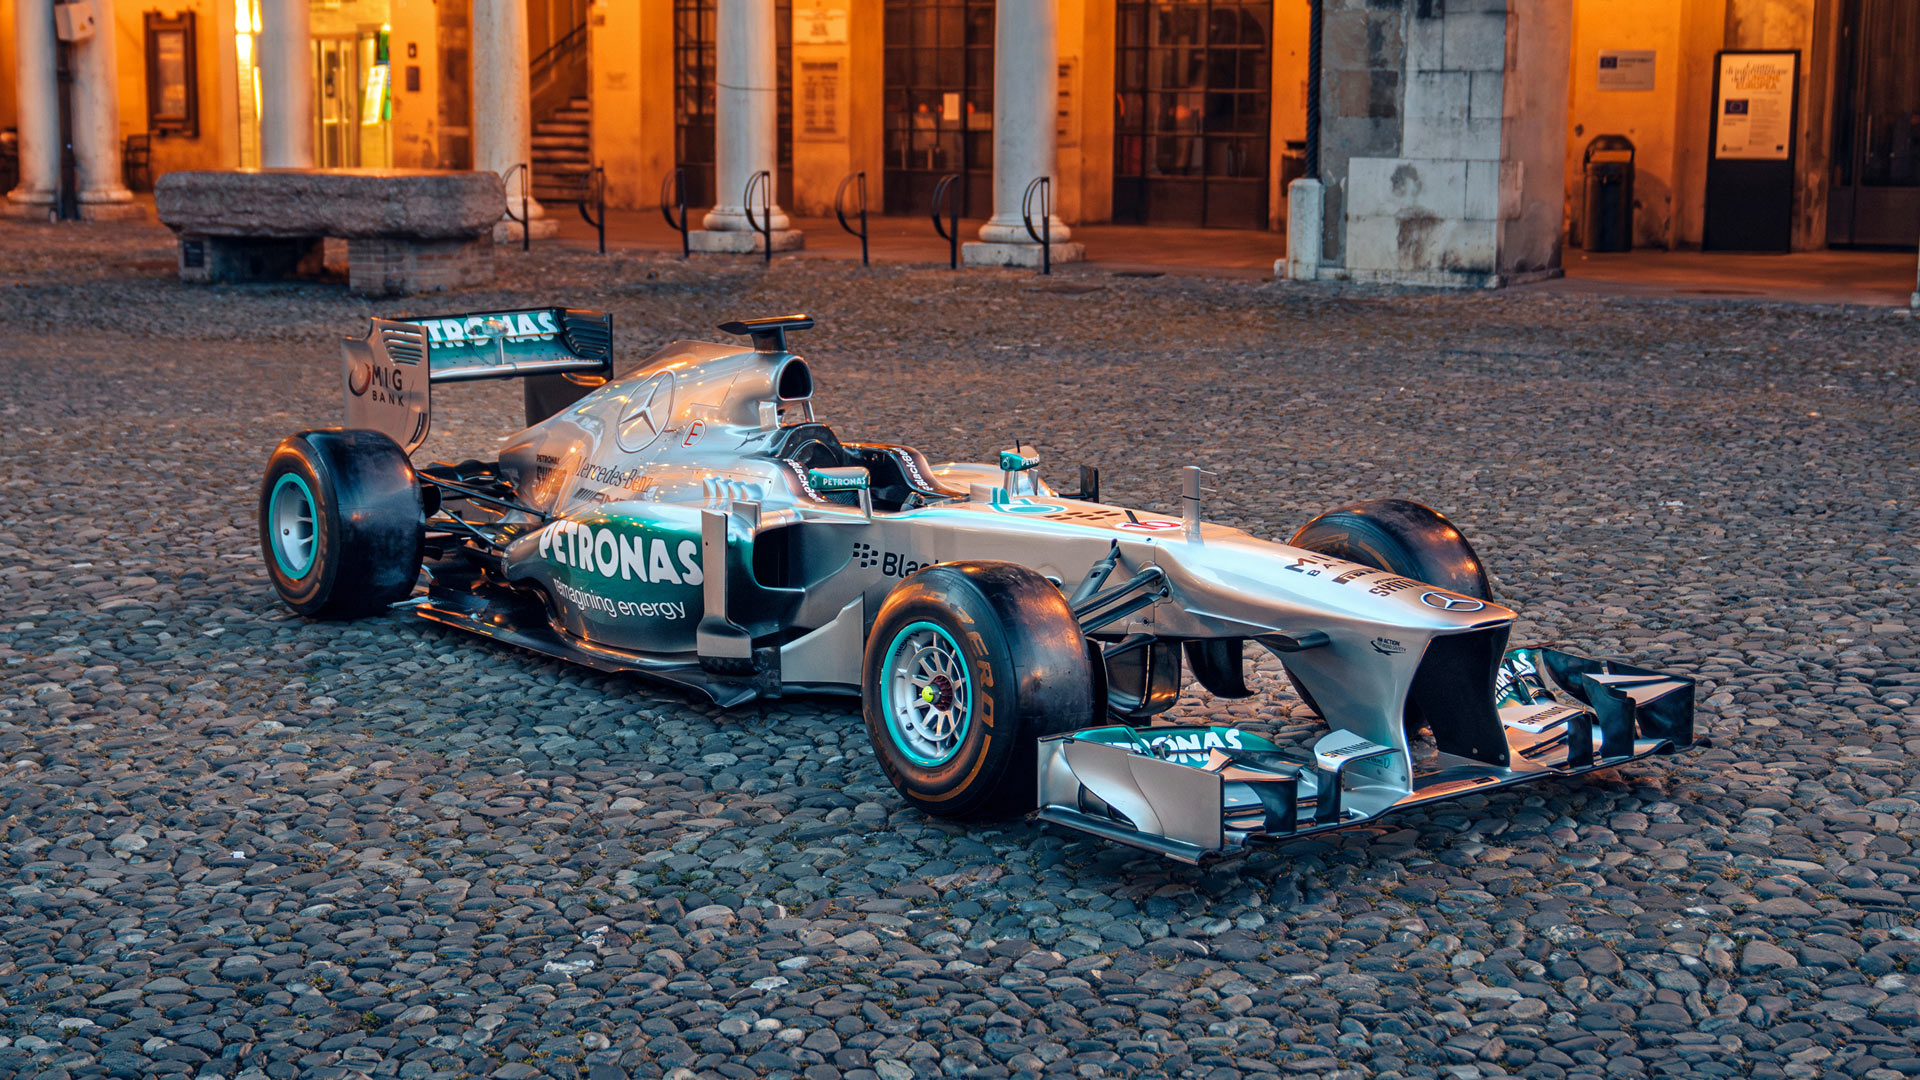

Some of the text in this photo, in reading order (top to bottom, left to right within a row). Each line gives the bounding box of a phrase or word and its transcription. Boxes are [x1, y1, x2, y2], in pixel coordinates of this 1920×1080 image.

[406, 312, 558, 349] TRONAS
[372, 364, 403, 391] MIG
[372, 390, 405, 407] BANK
[684, 422, 703, 446] E
[576, 456, 654, 493] Mercedes-Benz
[822, 476, 866, 486] PETRONAS
[589, 491, 626, 504] AM
[538, 519, 705, 586] PETRONAS
[882, 551, 939, 579] Bla
[1284, 555, 1330, 573] MI
[552, 578, 686, 620] reimagining energy
[1104, 728, 1243, 764] ONAS
